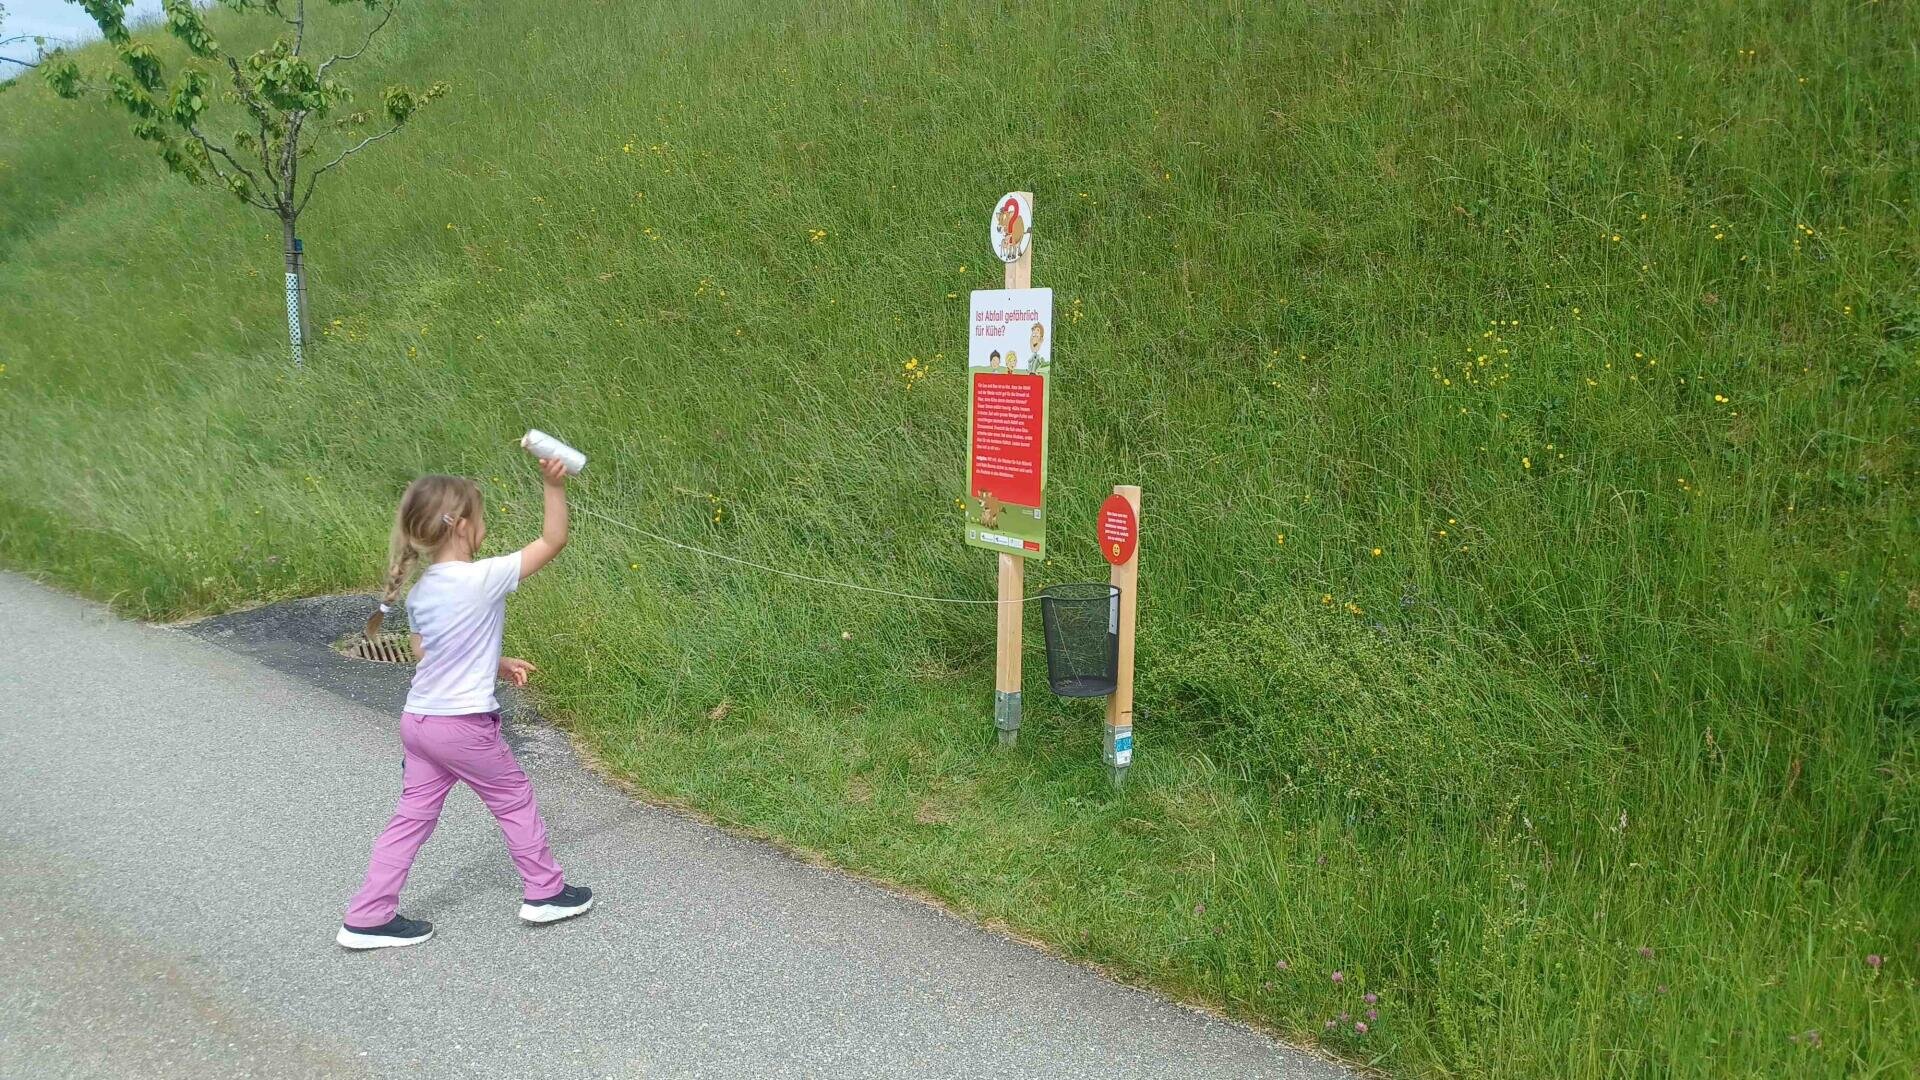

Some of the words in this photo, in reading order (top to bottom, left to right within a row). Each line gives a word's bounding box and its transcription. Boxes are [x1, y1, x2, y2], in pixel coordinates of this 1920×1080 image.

[976, 311, 984, 321] Ist
[985, 310, 1003, 321] Abfall
[1005, 309, 1038, 323] gefährlich
[976, 325, 984, 336] für
[986, 325, 1006, 336] Kühe?
